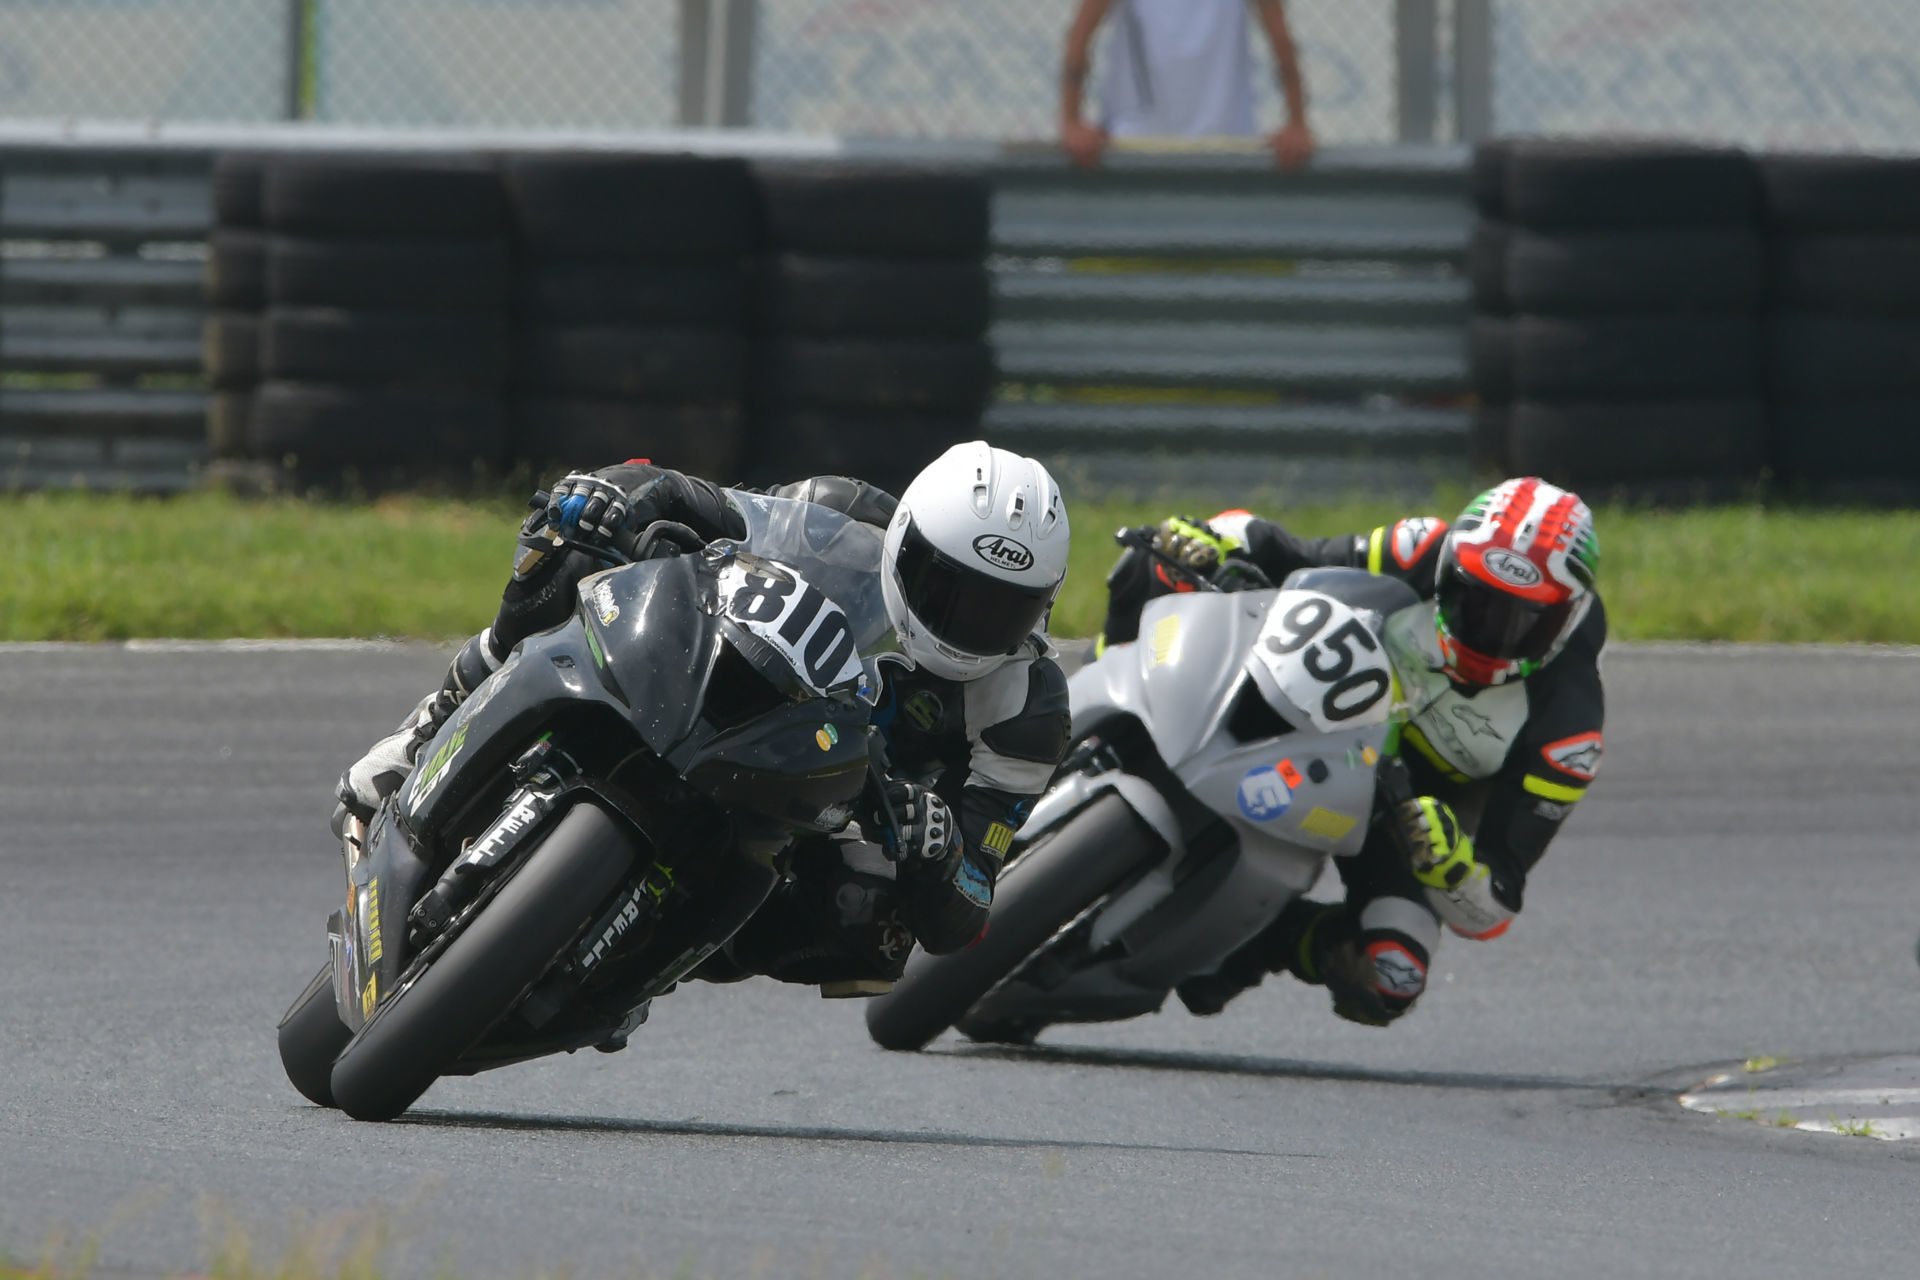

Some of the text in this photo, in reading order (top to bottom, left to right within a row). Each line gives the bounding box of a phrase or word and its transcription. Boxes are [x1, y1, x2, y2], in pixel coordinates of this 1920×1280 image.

[975, 538, 1030, 566] Arai
[729, 568, 855, 689] 810
[764, 634, 797, 666] Kawasaki
[1265, 598, 1390, 721] 950
